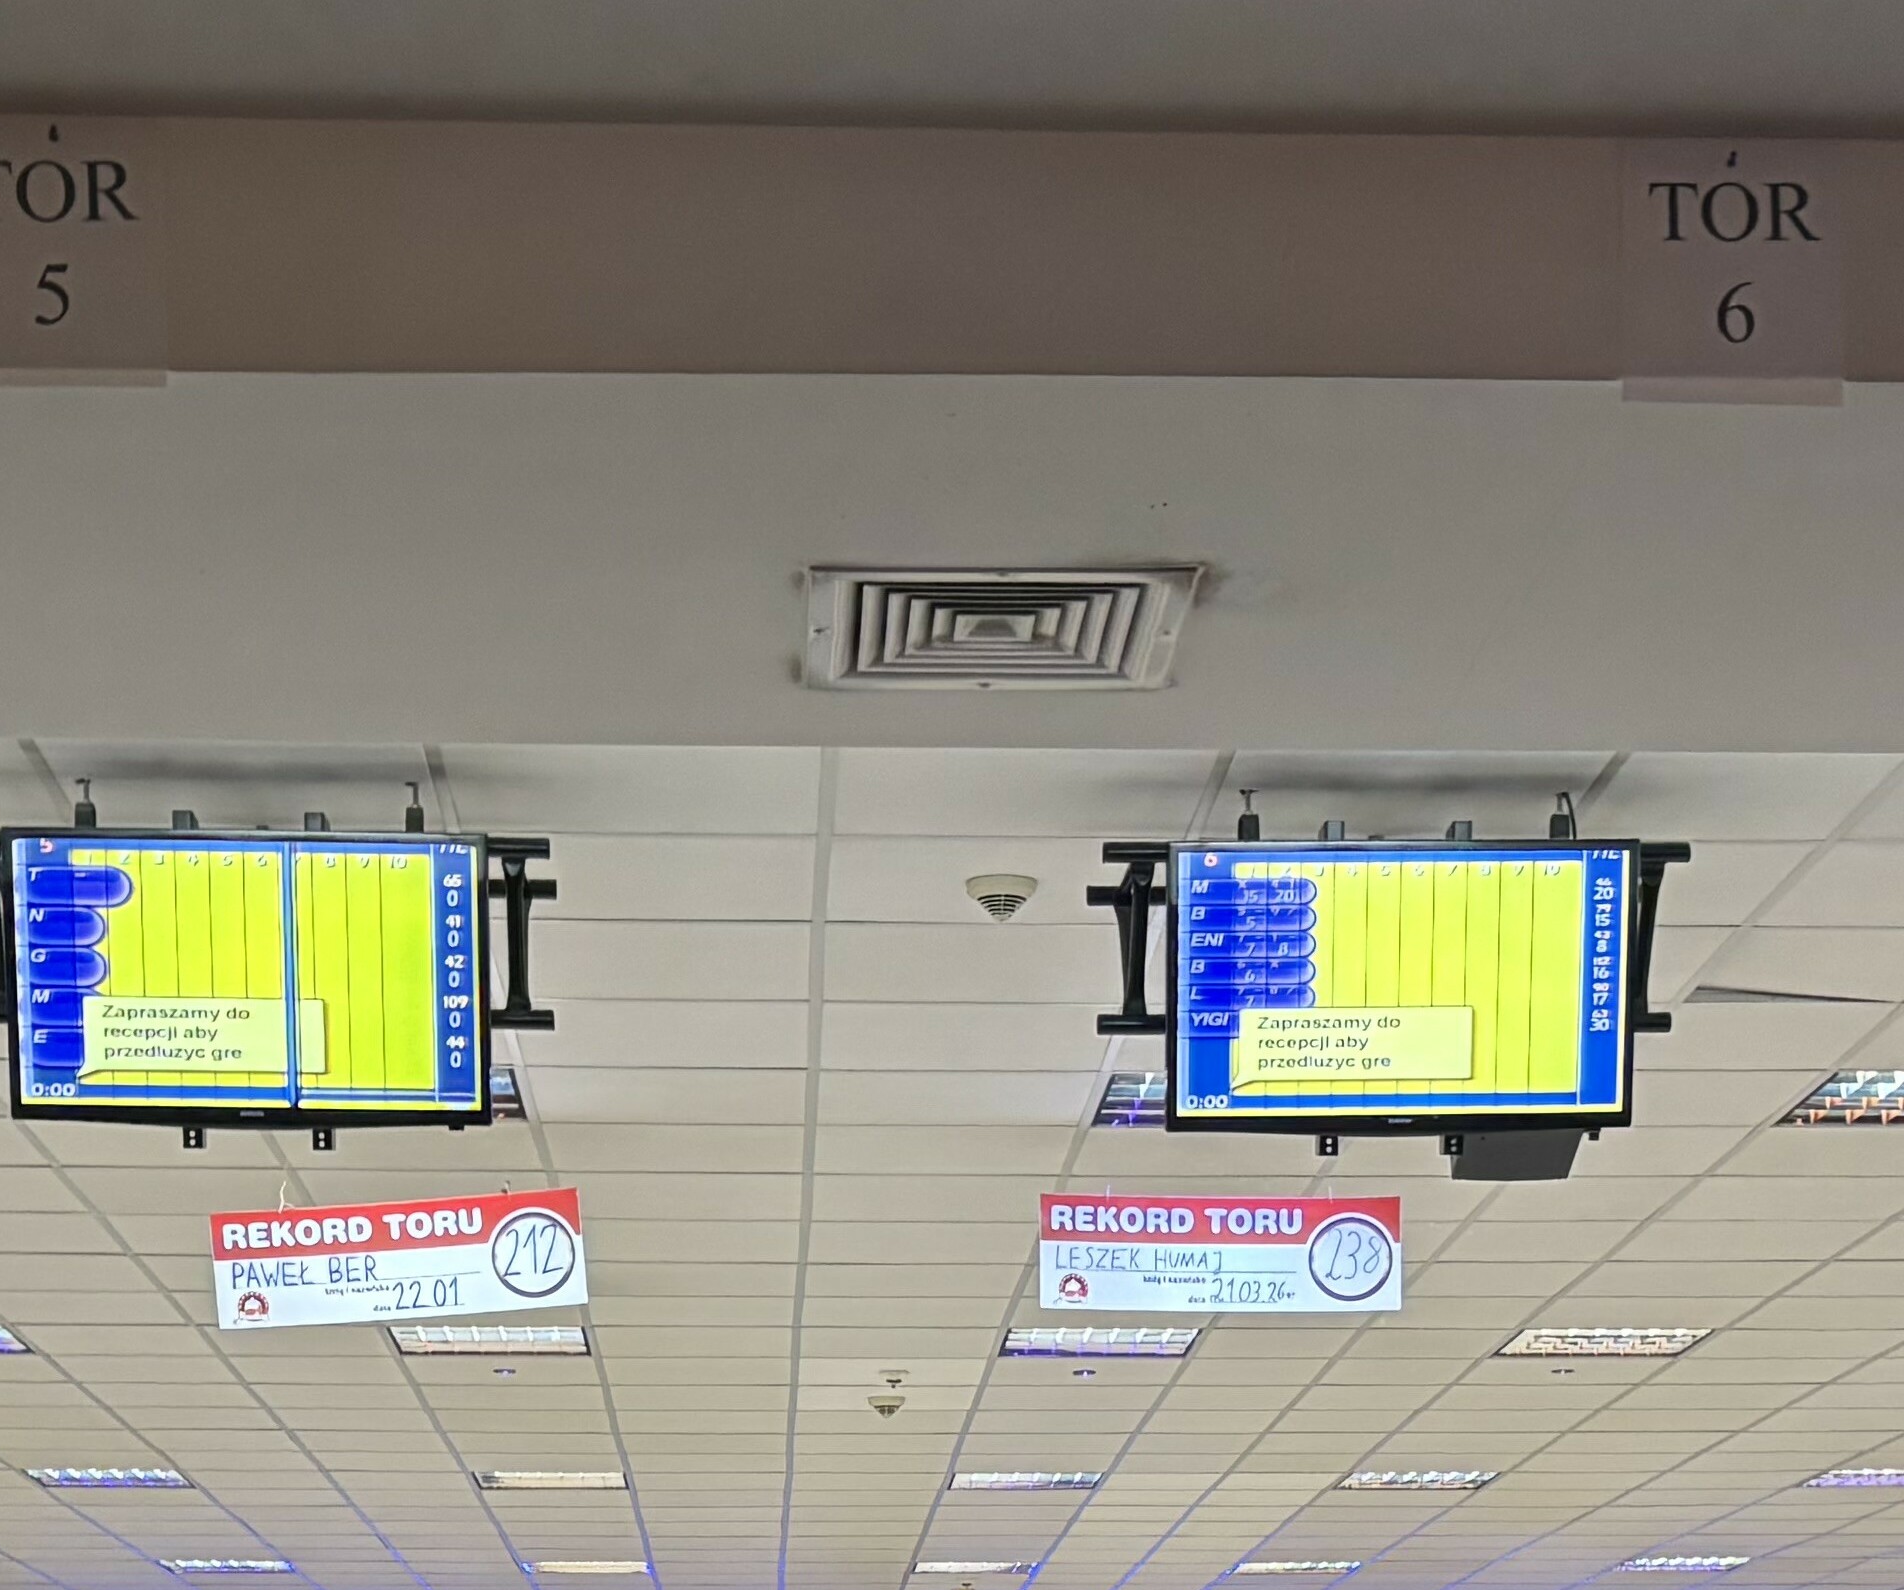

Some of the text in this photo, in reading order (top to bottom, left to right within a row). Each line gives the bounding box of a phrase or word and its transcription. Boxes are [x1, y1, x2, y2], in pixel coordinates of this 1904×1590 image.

[35, 263, 70, 326] 5
[1717, 281, 1756, 344] 6
[28, 867, 43, 882] T
[1191, 880, 1209, 894] M
[1593, 887, 1614, 900] 20
[447, 890, 459, 907] 0
[29, 908, 45, 923] N
[447, 930, 460, 947] 0
[1190, 933, 1224, 947] ENI
[30, 949, 46, 963] G
[444, 955, 465, 968] 42
[448, 971, 461, 988] 0
[31, 989, 51, 1004] M
[443, 995, 469, 1009] 109
[102, 1005, 250, 1022] Zapraszamy do
[449, 1011, 461, 1028] 0
[1191, 1012, 1230, 1027] YIGI
[1257, 1016, 1401, 1032] Zapraszamy do
[33, 1029, 48, 1044] E
[104, 1026, 218, 1041] recepcji aby
[446, 1036, 465, 1049] 44
[1258, 1035, 1369, 1051] recepcji aby
[104, 1046, 242, 1061] przedluzyc gre
[450, 1051, 462, 1068] 0
[1258, 1056, 1391, 1071] przedluzyc gre
[31, 1083, 76, 1097] 0:00
[1186, 1094, 1228, 1109] 0:00
[1050, 1205, 1303, 1235] REKORD TORU
[221, 1207, 483, 1250] REKORD TORU
[503, 1223, 564, 1278] 212
[1325, 1228, 1382, 1281] 238
[1055, 1244, 1223, 1273] LESZEK HUMAJ
[232, 1261, 319, 1290] PAWEŁ
[329, 1255, 379, 1284] BER
